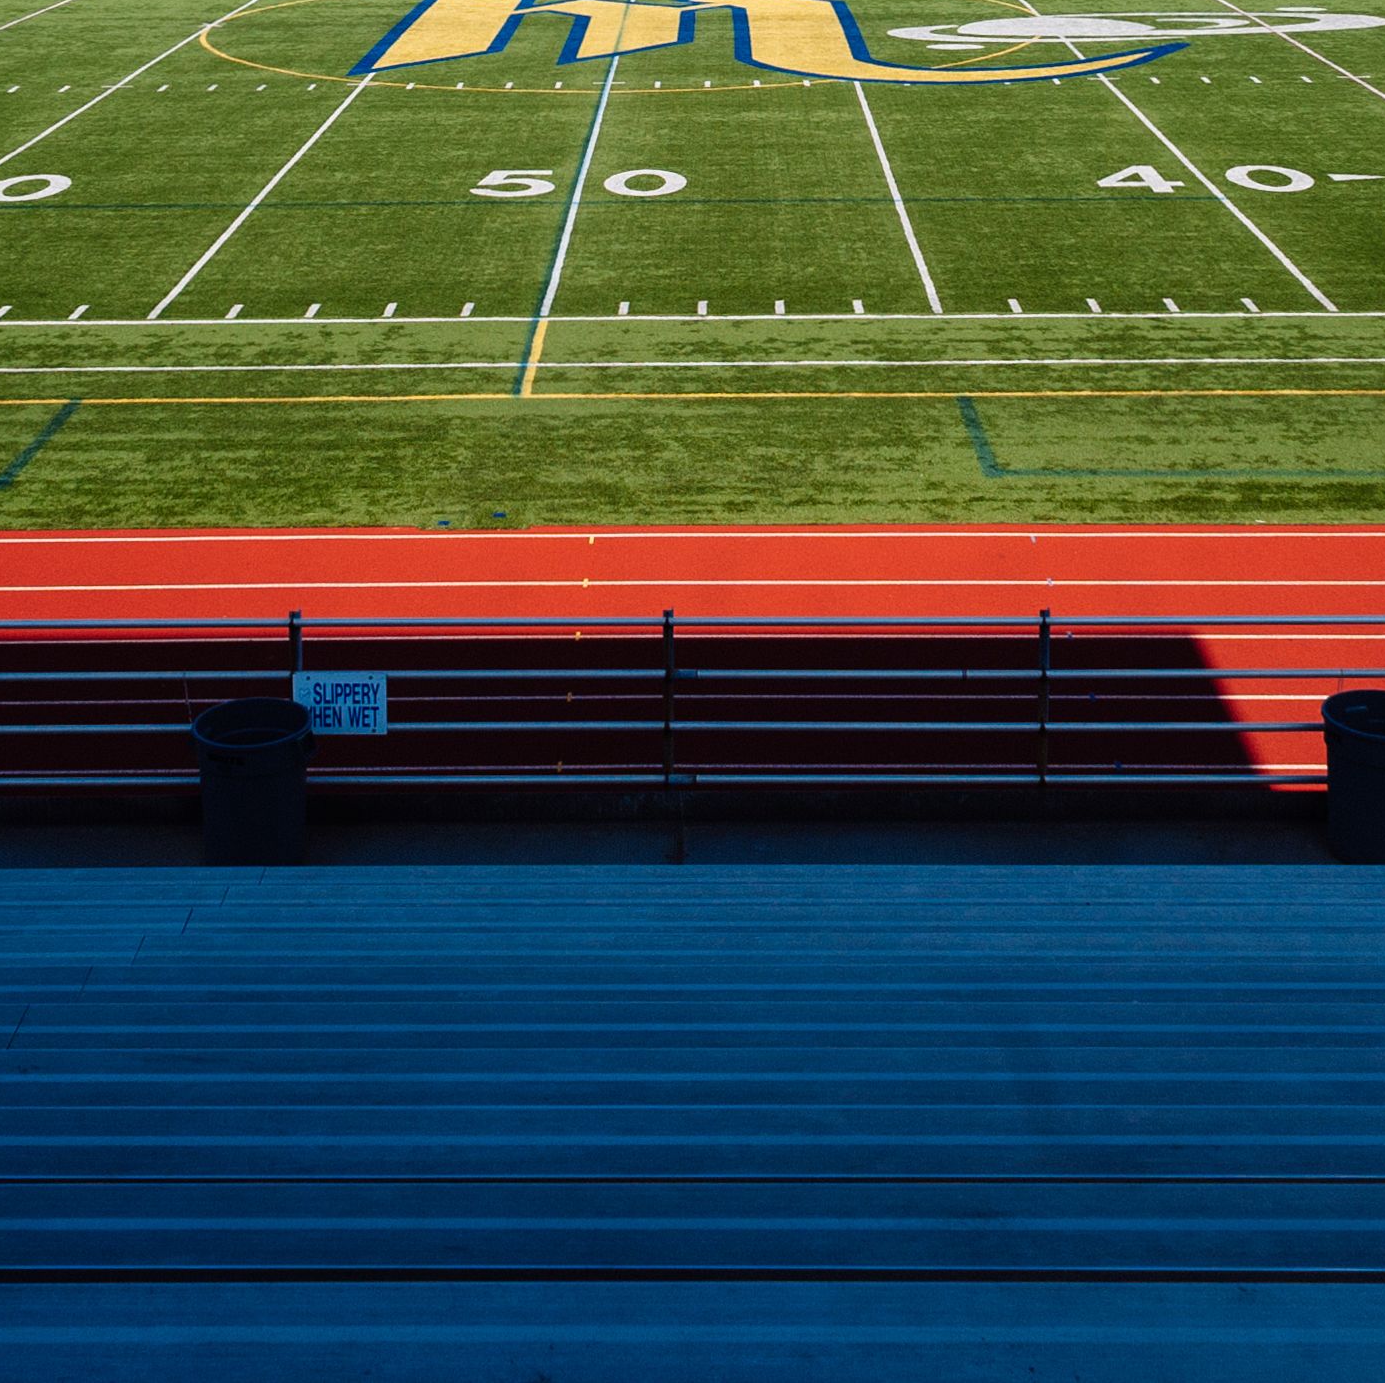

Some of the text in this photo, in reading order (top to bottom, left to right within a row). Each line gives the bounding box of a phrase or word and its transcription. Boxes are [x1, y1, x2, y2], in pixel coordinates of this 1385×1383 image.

[469, 168, 688, 198] 50
[1096, 164, 1315, 193] 40
[313, 682, 380, 705] SLIPPERY
[309, 706, 379, 728] HEN WET
